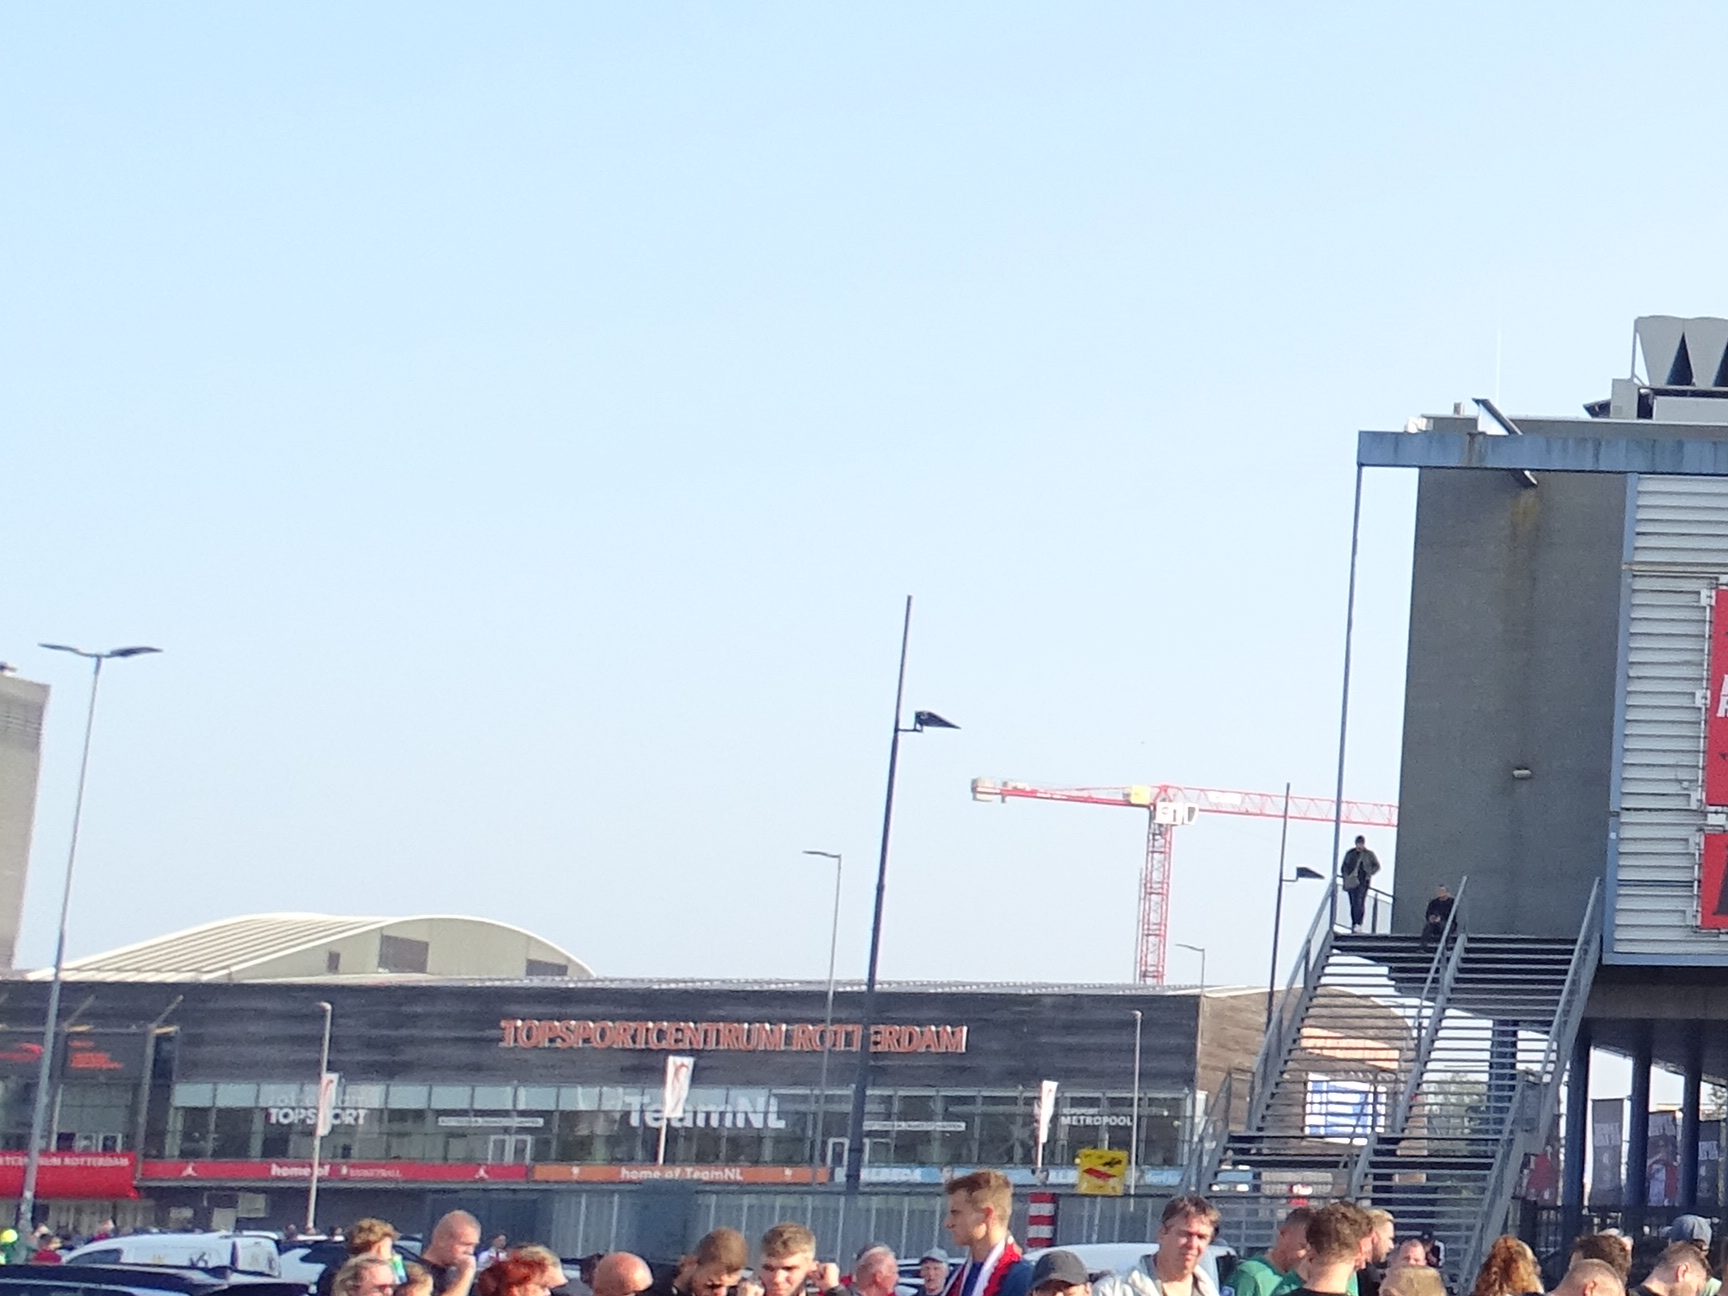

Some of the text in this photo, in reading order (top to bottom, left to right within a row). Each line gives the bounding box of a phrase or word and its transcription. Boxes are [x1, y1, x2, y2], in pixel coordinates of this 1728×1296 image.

[500, 1020, 968, 1053] TOPSPORTCENTRUM ROTTERDAM
[269, 1108, 368, 1125] TOPSORT
[1060, 1115, 1133, 1126] METROPOOL
[620, 1167, 743, 1181] home of TeamNL
